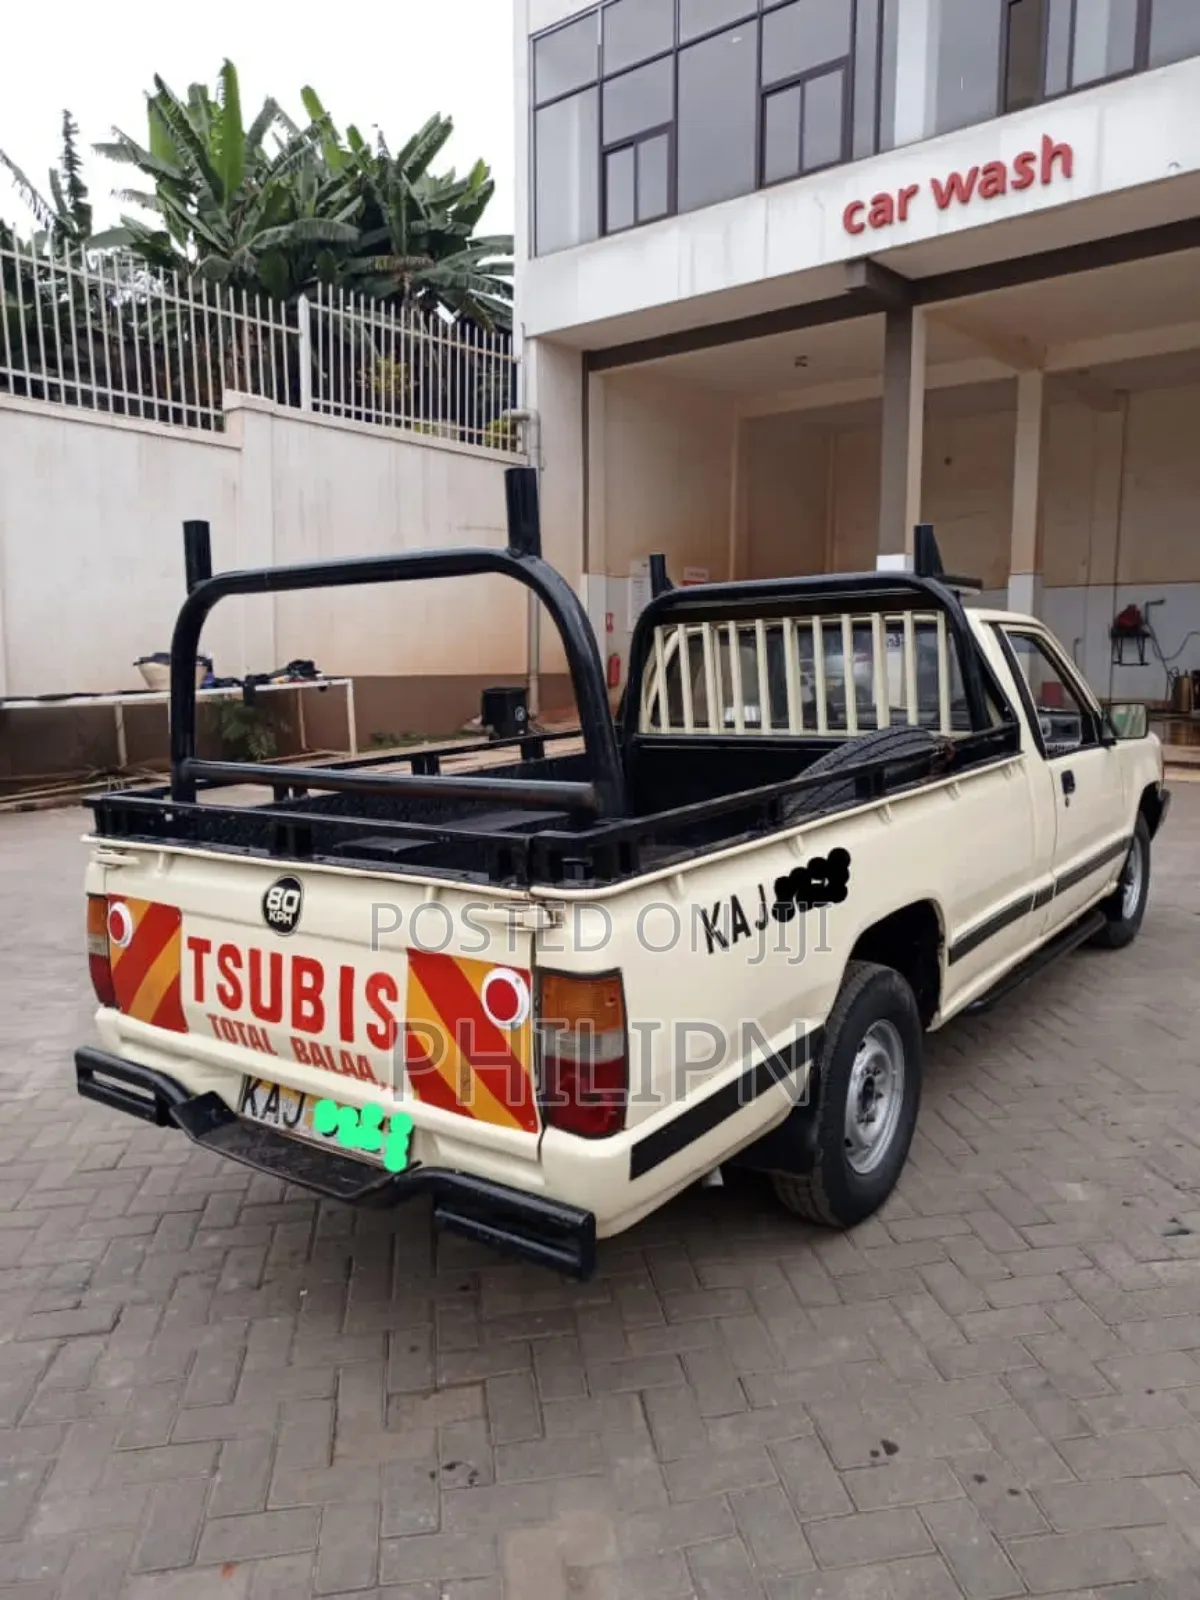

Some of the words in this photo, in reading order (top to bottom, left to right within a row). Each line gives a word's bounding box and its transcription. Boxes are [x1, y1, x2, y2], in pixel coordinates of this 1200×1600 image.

[843, 184, 919, 235] car
[930, 133, 1073, 209] wash
[266, 886, 300, 914] 80
[268, 909, 293, 925] KPH
[187, 936, 398, 1051] TSUBIS
[207, 1013, 278, 1057] TOTAL
[241, 1074, 306, 1129] KAJ
